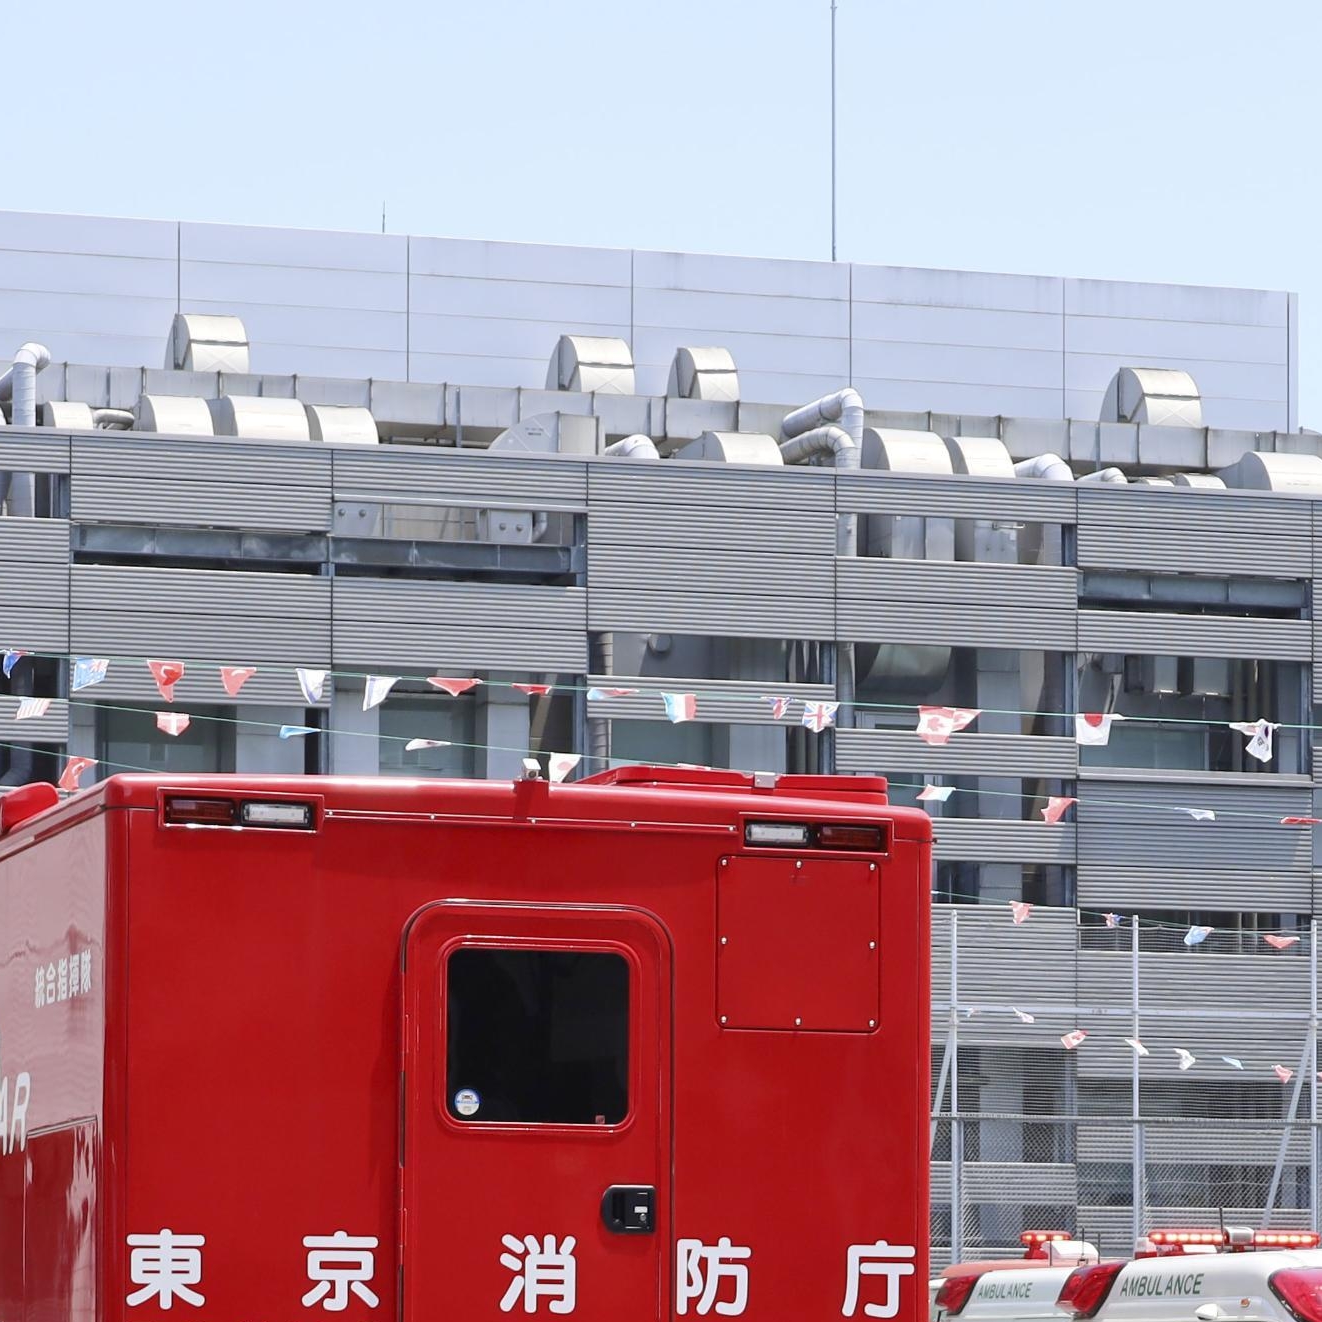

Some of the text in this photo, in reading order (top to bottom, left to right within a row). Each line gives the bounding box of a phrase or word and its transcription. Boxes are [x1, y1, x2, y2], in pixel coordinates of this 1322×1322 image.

[126, 1229, 915, 1318] 東京消防庁
[1119, 1273, 1204, 1297] AMBULANCE
[978, 1282, 1032, 1299] AMBULANCE
